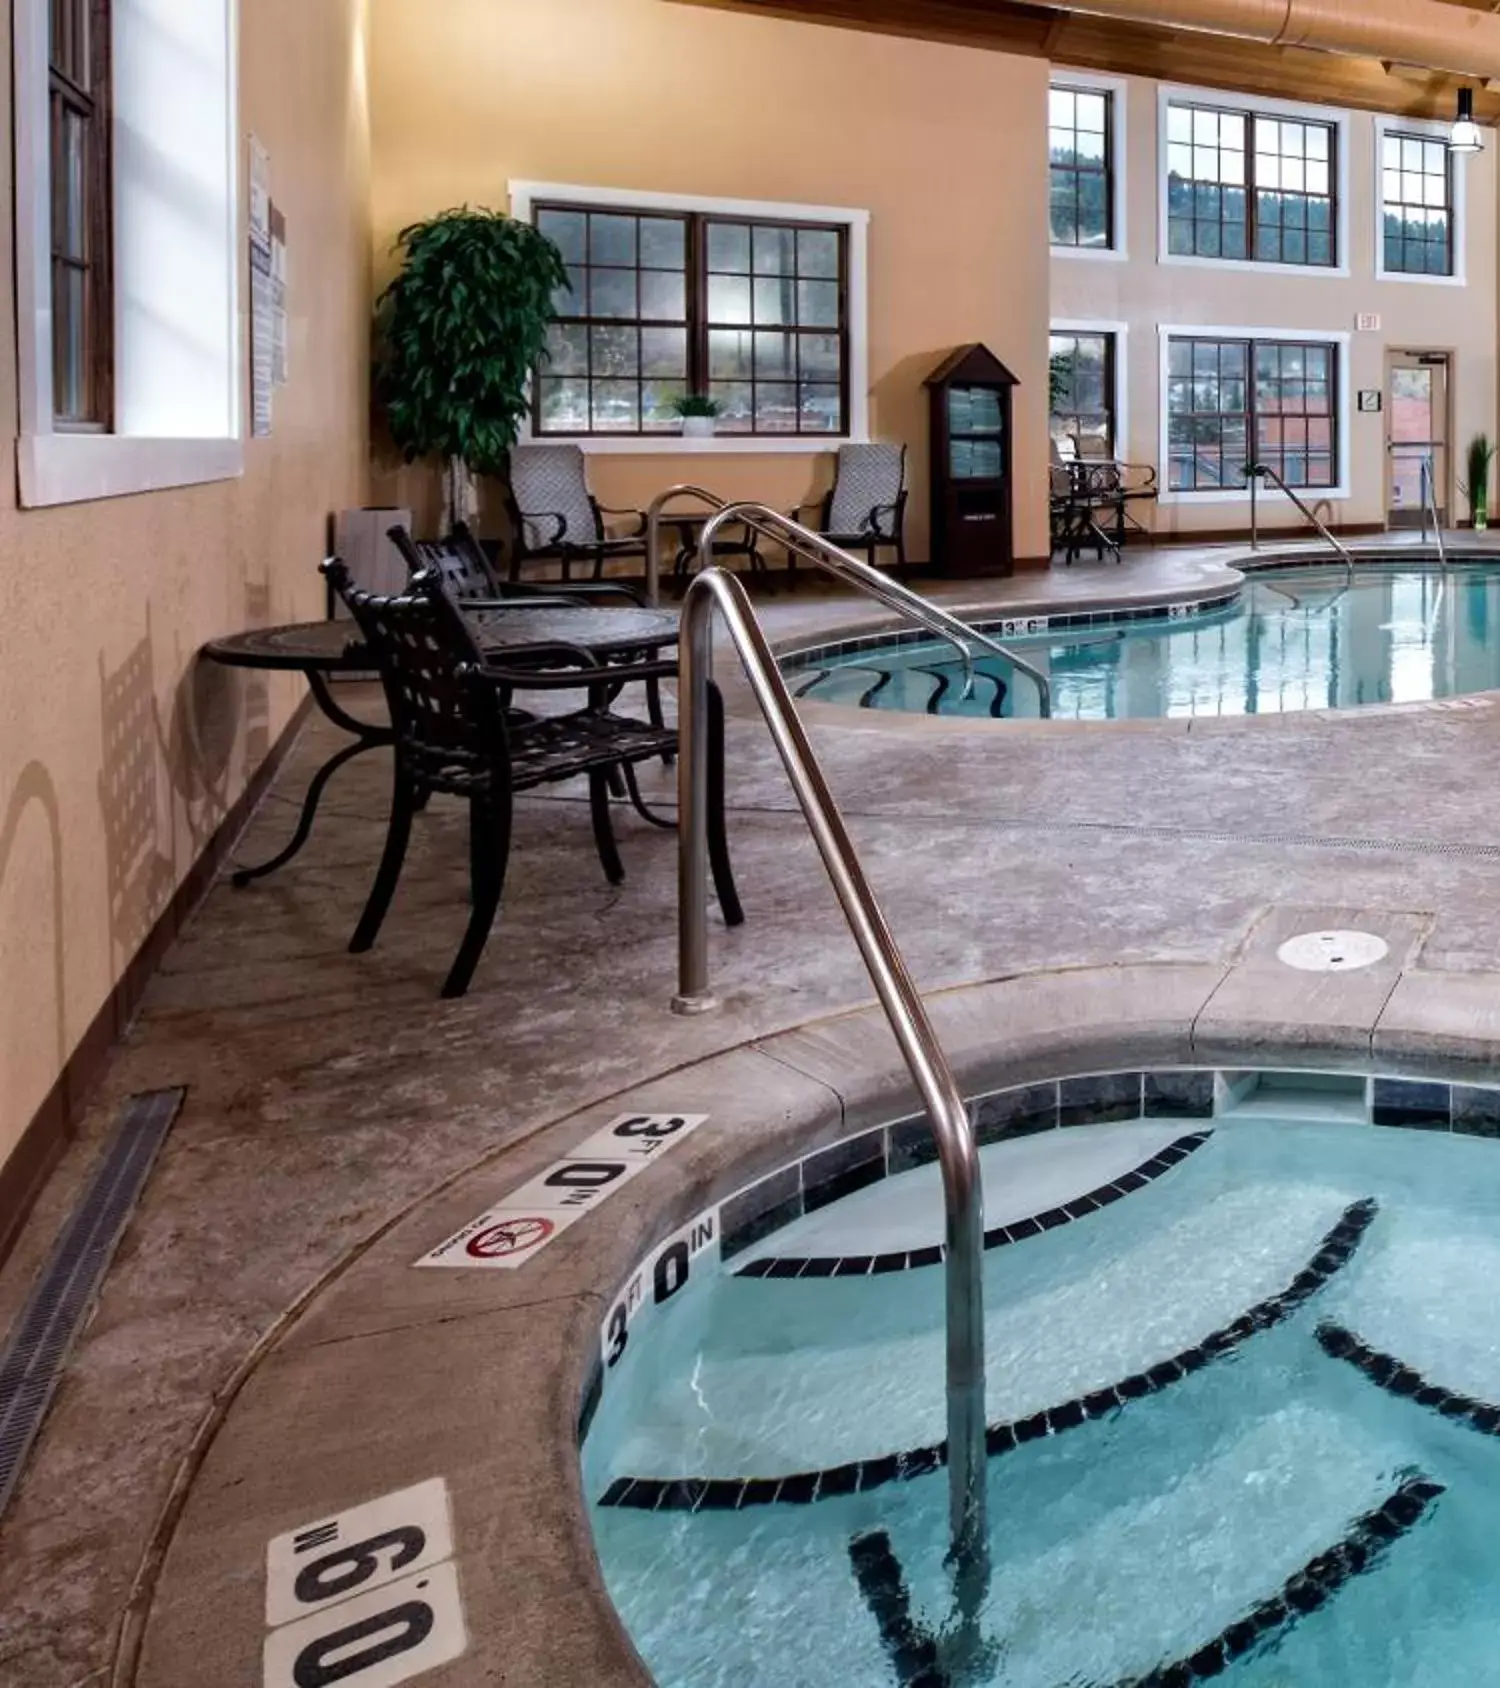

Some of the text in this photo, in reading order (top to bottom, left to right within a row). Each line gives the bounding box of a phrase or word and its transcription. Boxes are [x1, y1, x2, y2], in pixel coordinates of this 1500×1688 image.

[544, 1116, 685, 1205] 3 FT 0 IN
[607, 1217, 713, 1368] 3 FT 0 IN
[293, 1520, 435, 1688] 0.9 M
